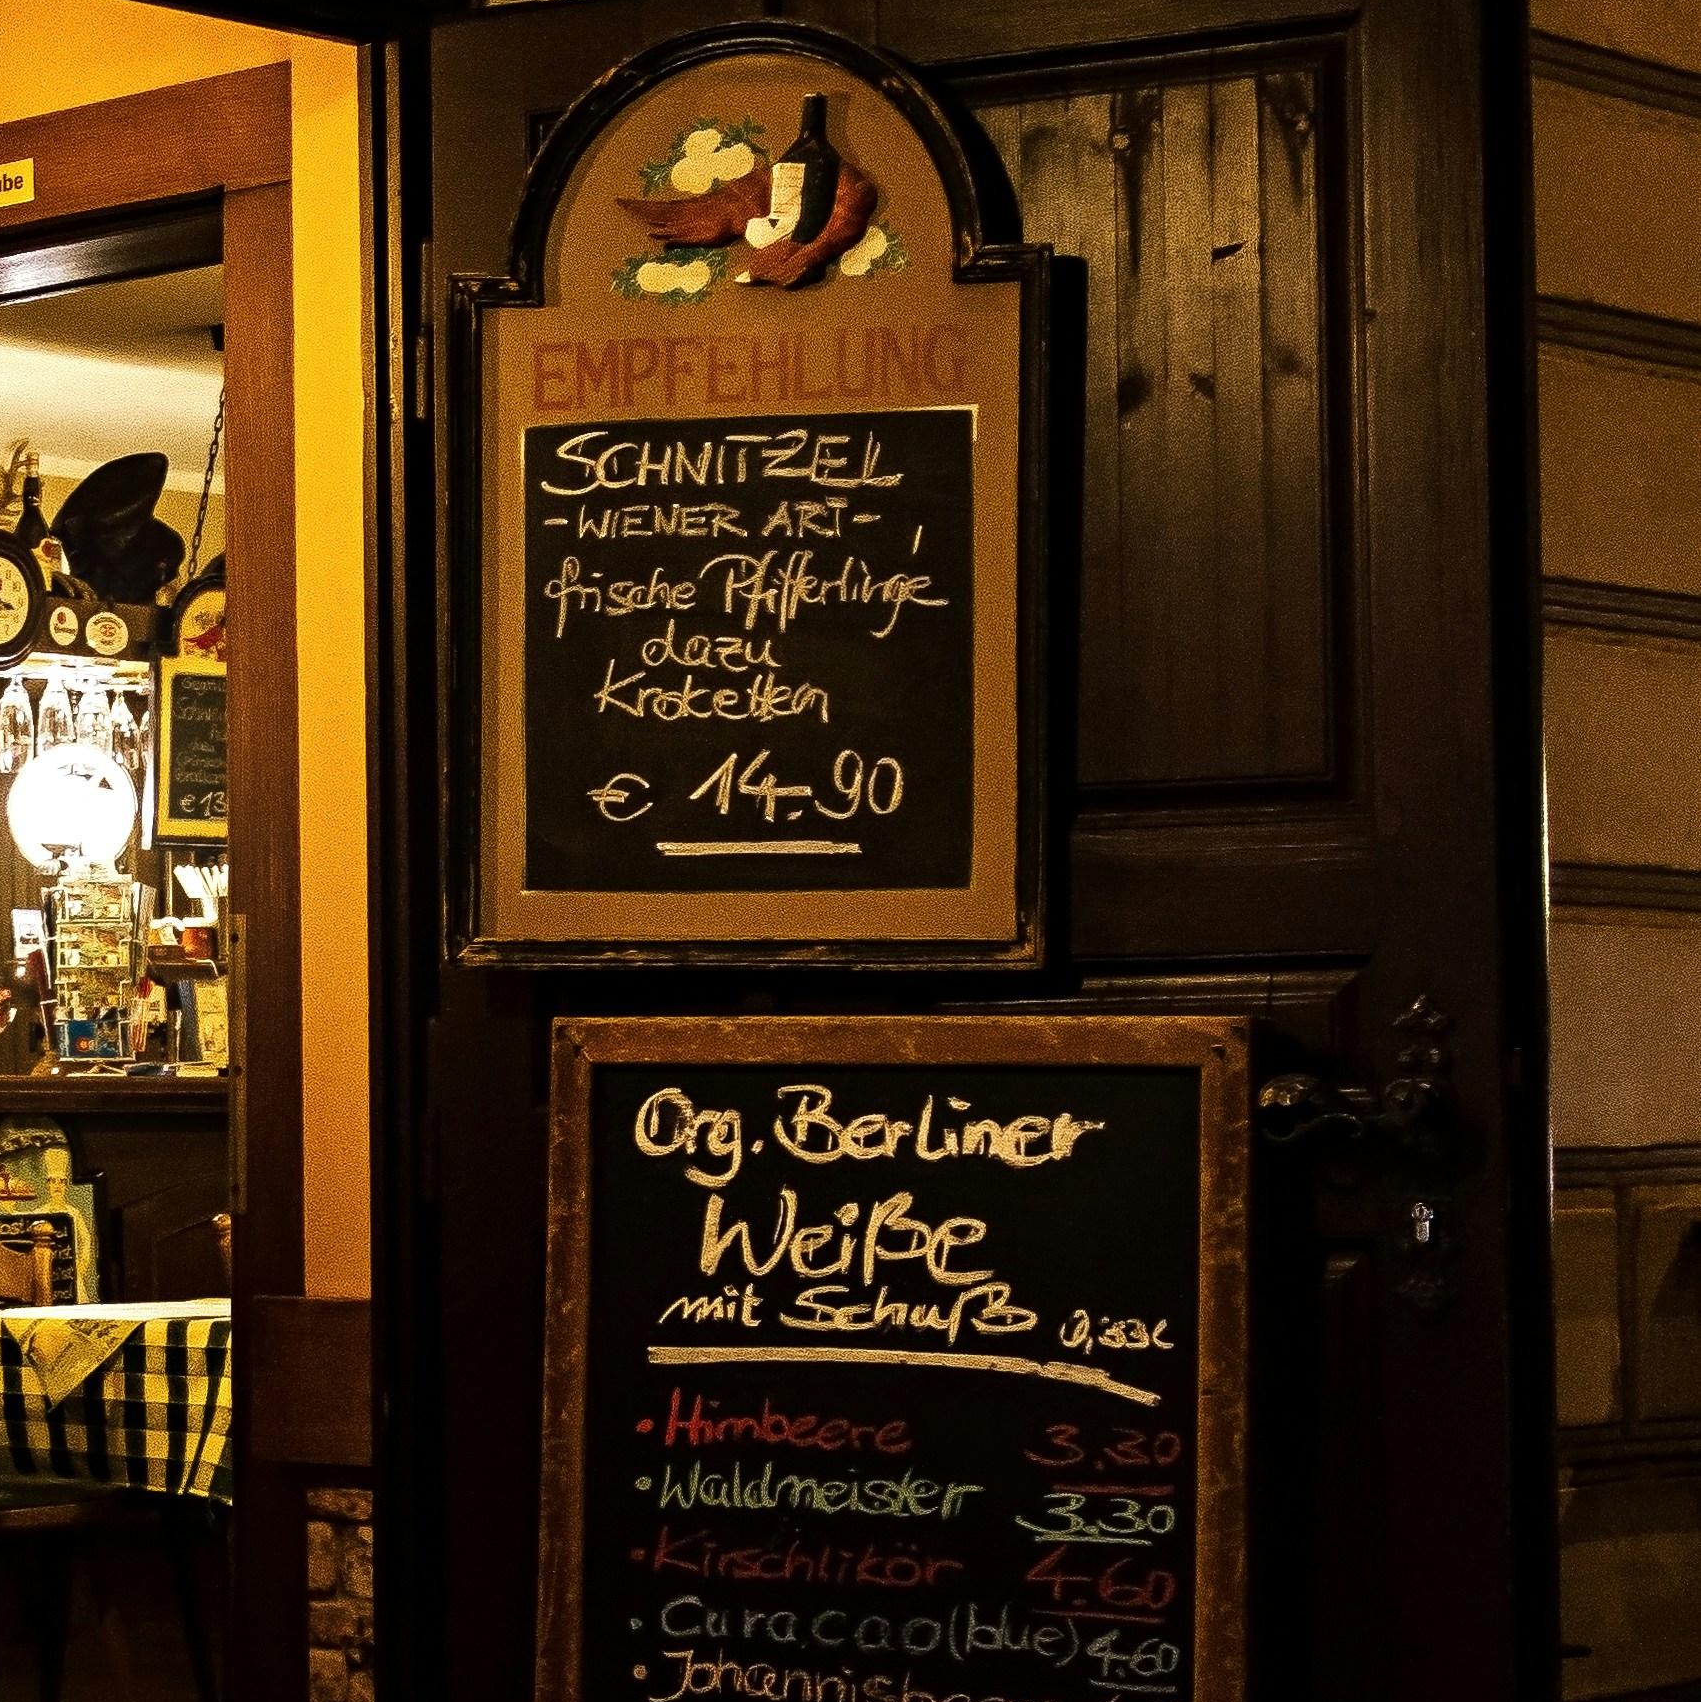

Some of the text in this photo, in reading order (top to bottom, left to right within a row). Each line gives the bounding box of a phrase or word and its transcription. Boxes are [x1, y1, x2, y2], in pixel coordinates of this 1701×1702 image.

[530, 321, 968, 413] EMPFEHLUNG
[540, 427, 904, 497] SCHNITZEL
[543, 553, 697, 638] frische
[639, 619, 783, 673] dazu
[595, 659, 831, 724] Kroketten
[587, 749, 905, 824] € 14.90
[634, 1084, 1105, 1187] Org. Berliner
[657, 1283, 763, 1326] mit
[663, 1387, 1182, 1469] Himbeere 3.30
[658, 1462, 1177, 1537] Waldmeister 3.30
[653, 1525, 965, 1588] Kirschlikör
[1086, 1629, 1179, 1678] 4.60
